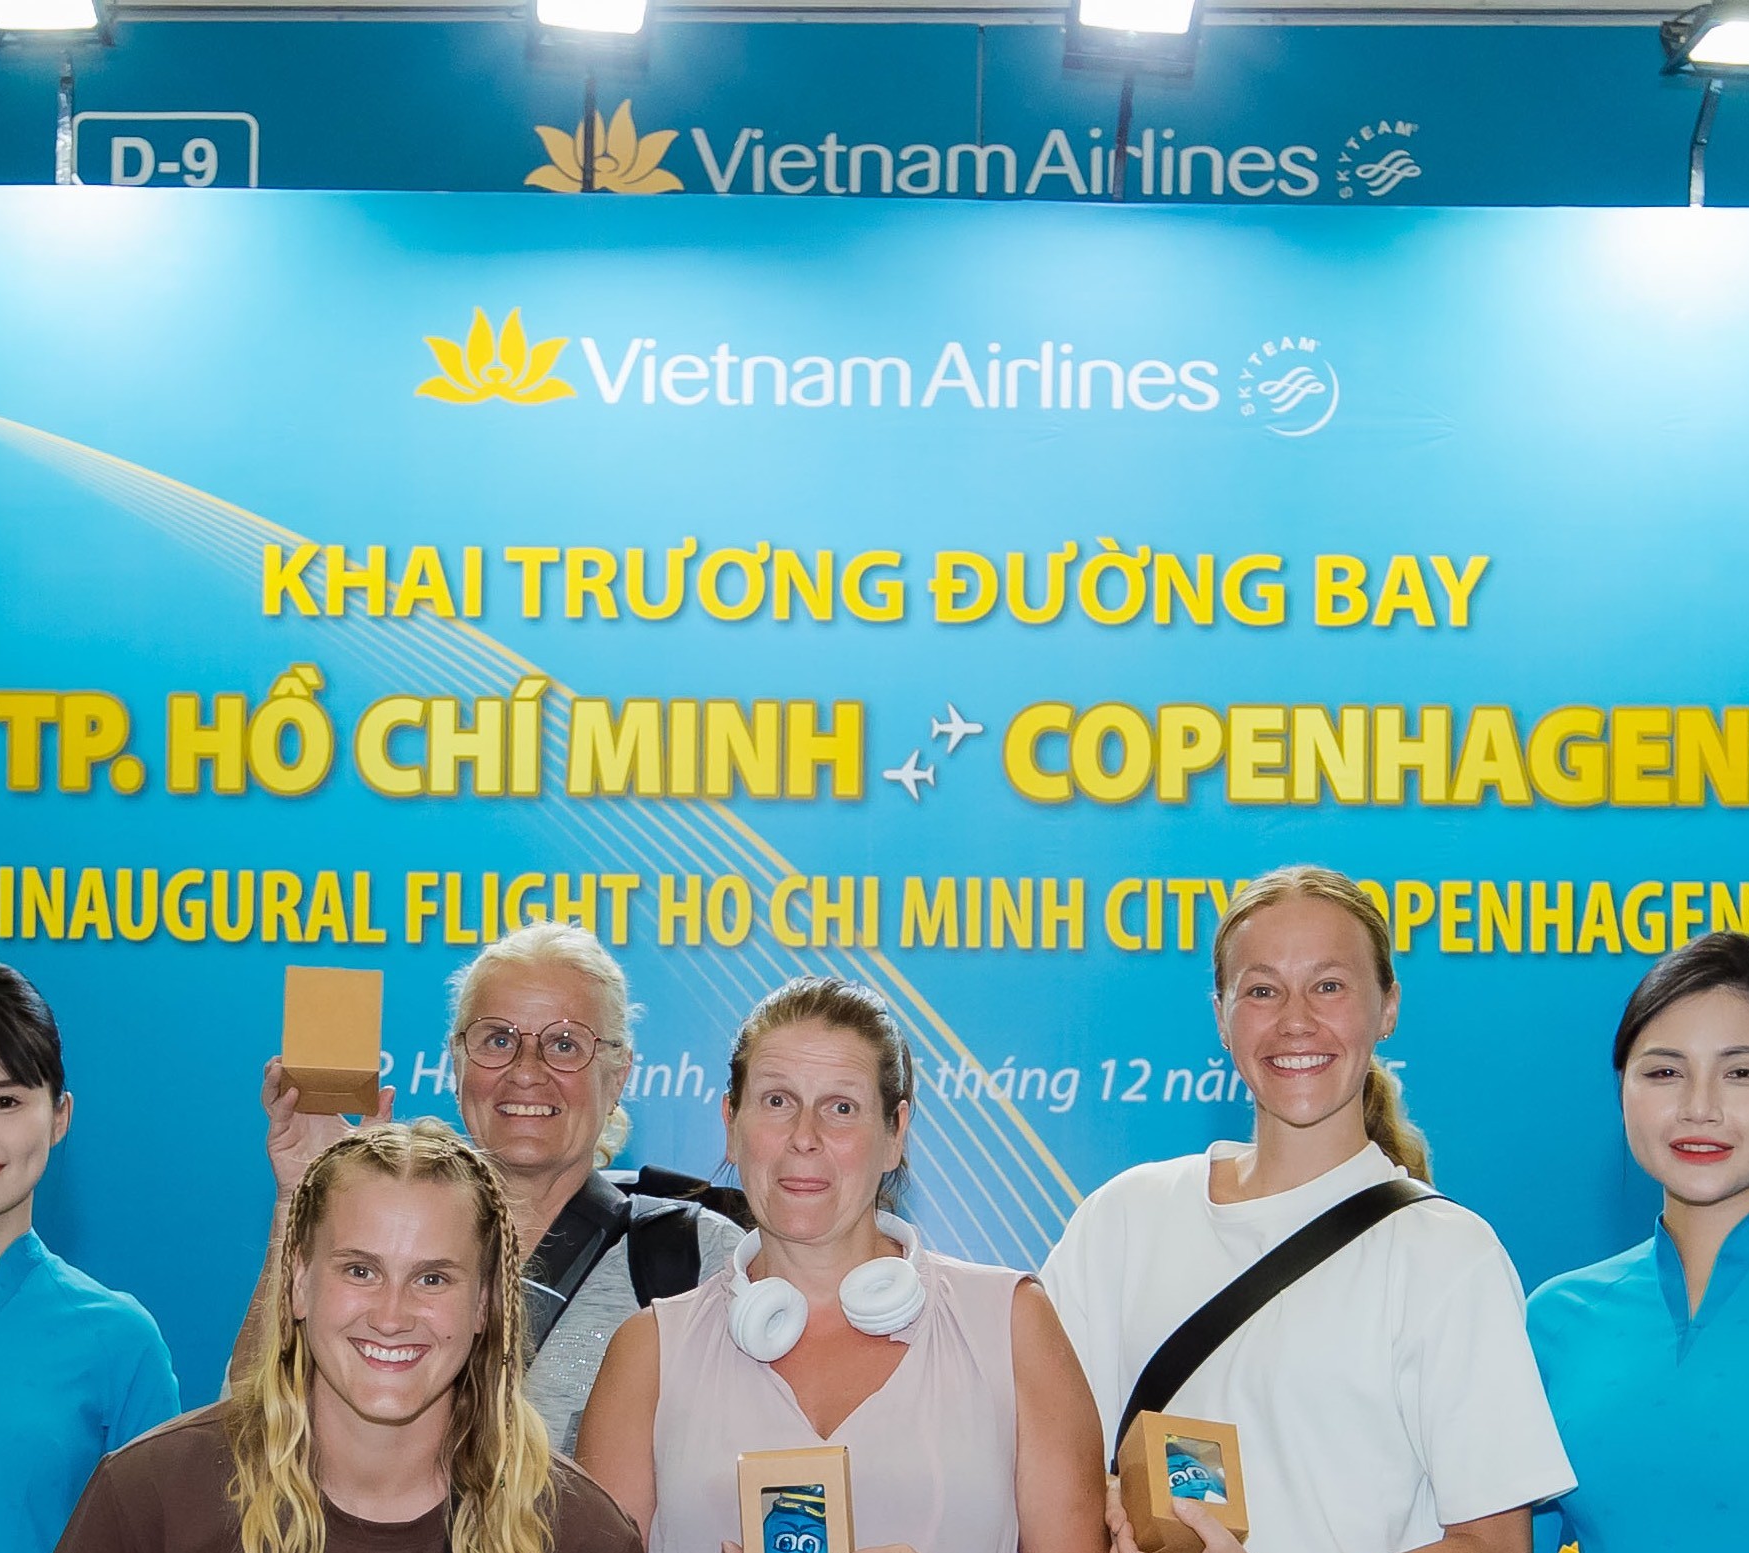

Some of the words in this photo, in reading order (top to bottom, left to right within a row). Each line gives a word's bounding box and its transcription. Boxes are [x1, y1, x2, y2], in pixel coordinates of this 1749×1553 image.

[110, 136, 219, 188] D-9
[691, 126, 1016, 194] Vietnam
[1025, 127, 1319, 197] Airlines
[580, 337, 911, 407] Vietnam
[921, 341, 1220, 412] Airlines
[1239, 336, 1316, 416] SKYTEAM
[262, 544, 483, 619] KHAI
[506, 536, 904, 623] TRƯƠNG
[930, 537, 1283, 626] ĐƯỜNG
[1314, 555, 1491, 627] BAY
[165, 664, 336, 796] HỒ
[354, 674, 552, 797] CHÍ
[567, 699, 864, 799] MINH
[406, 871, 640, 945] FLIGHT
[659, 874, 754, 947] HO
[769, 875, 879, 949] CHI
[901, 877, 1085, 951] MINH
[629, 1051, 716, 1104] inh,
[937, 1055, 1081, 1113] tháng
[1100, 1057, 1151, 1101] 12
